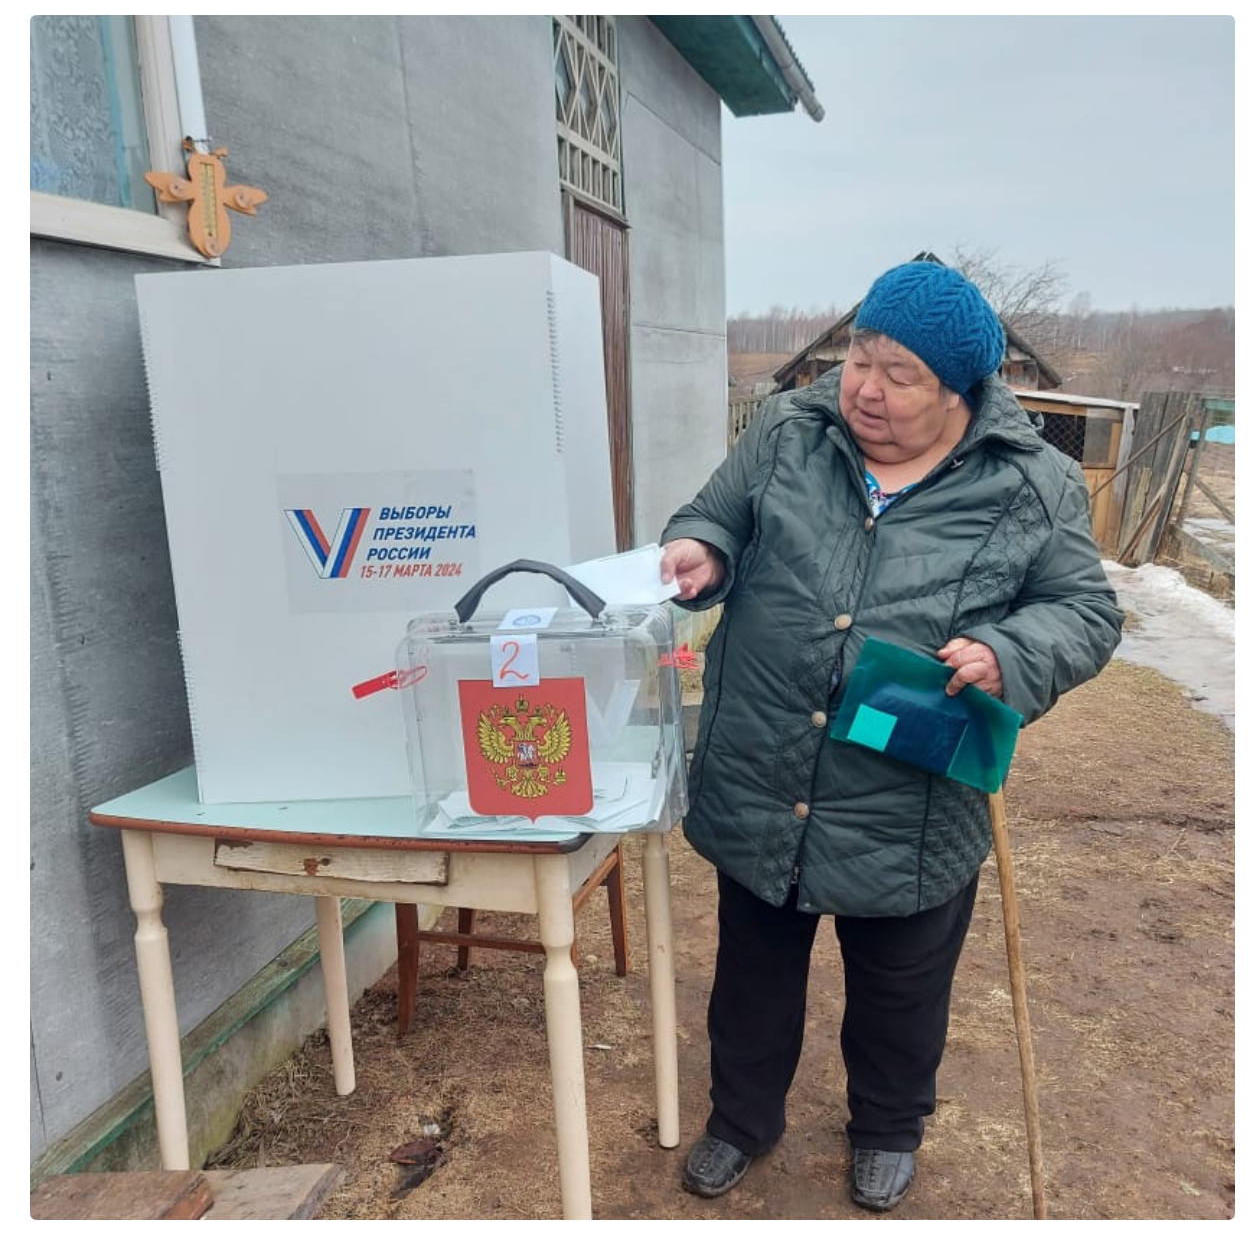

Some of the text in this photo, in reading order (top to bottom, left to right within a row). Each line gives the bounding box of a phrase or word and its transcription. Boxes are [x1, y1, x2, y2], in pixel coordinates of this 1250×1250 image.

[379, 505, 452, 520] ВЫБОРЫ
[373, 525, 476, 542] ПРЕЗИДЕНТА
[367, 547, 431, 561] РОССИИ
[360, 563, 463, 578] 15-17 МАРТА 2024
[499, 641, 529, 680] 2
